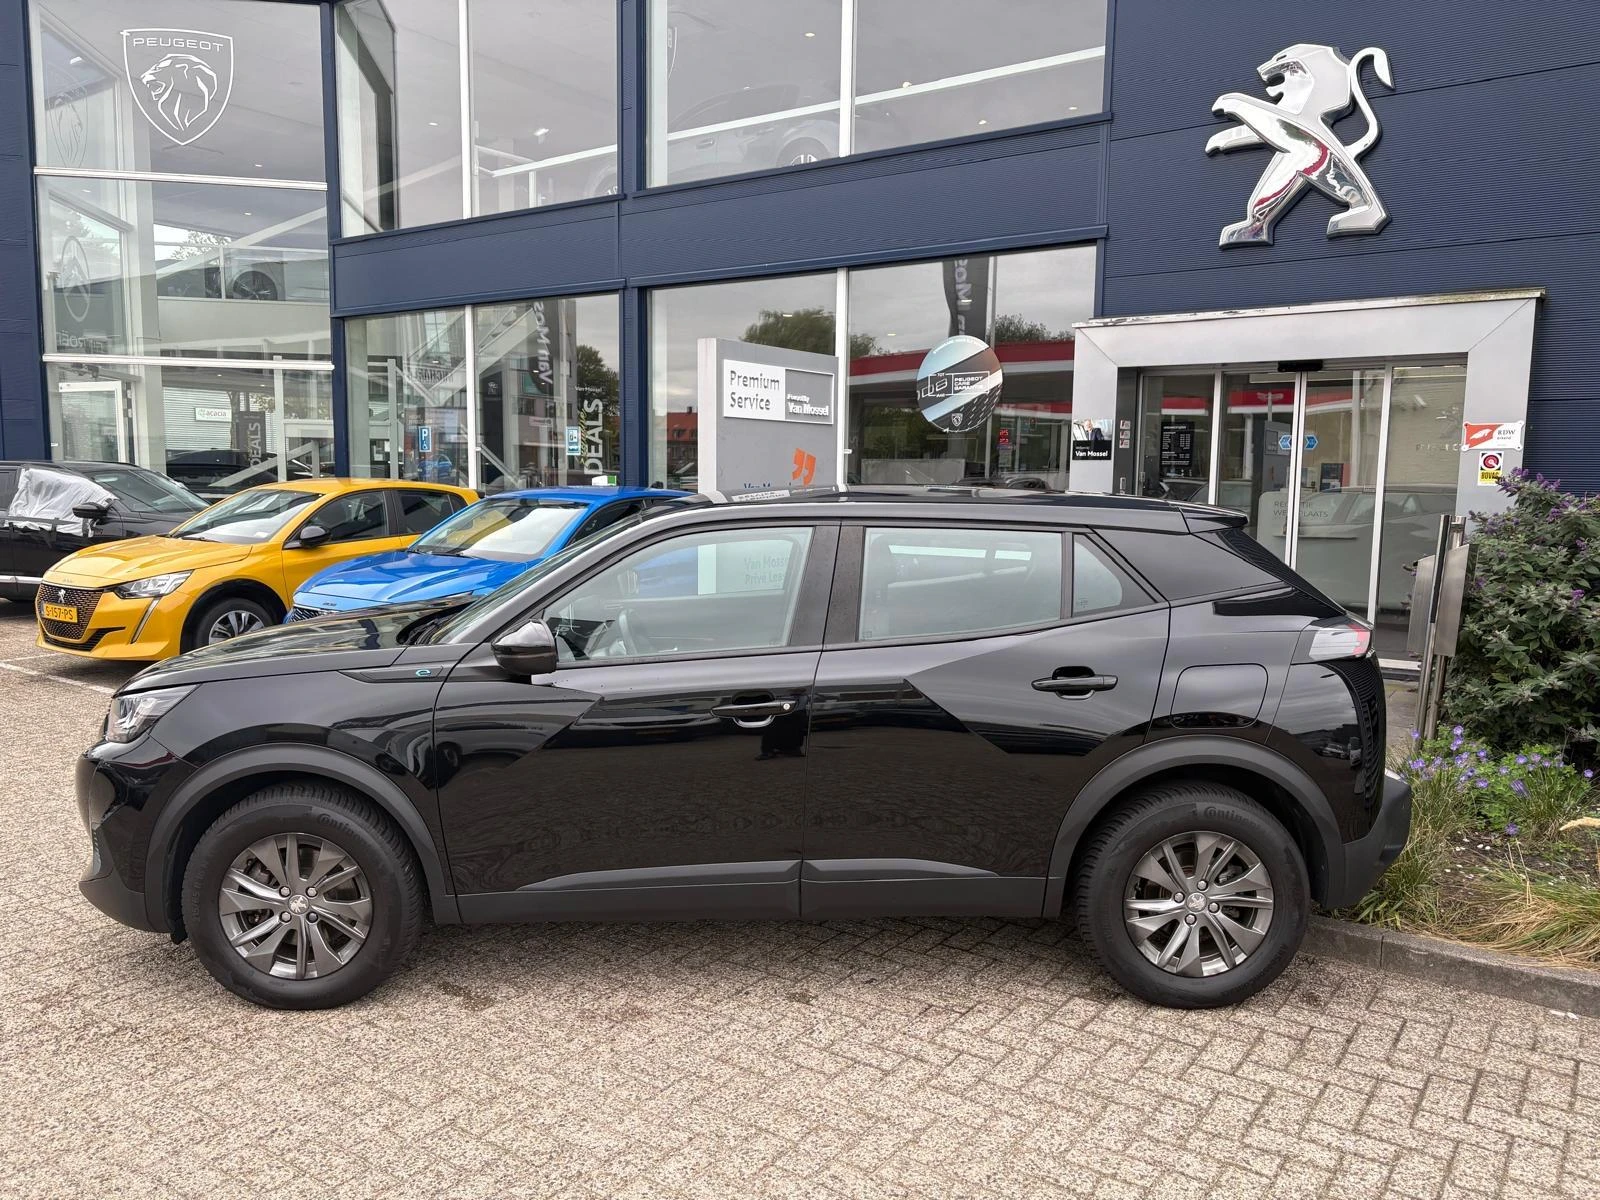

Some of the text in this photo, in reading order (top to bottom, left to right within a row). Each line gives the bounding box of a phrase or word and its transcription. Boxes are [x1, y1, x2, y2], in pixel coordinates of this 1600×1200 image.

[133, 37, 223, 52] PEUGEOT
[729, 370, 780, 391] Premium
[729, 391, 771, 411] Service
[788, 402, 829, 416] Van Mossel
[421, 428, 429, 441] P
[583, 398, 603, 475] DEALS
[1273, 500, 1313, 509] RECTIE
[1273, 509, 1329, 519] WEPLAATS
[45, 604, 74, 621] S-157-PS
